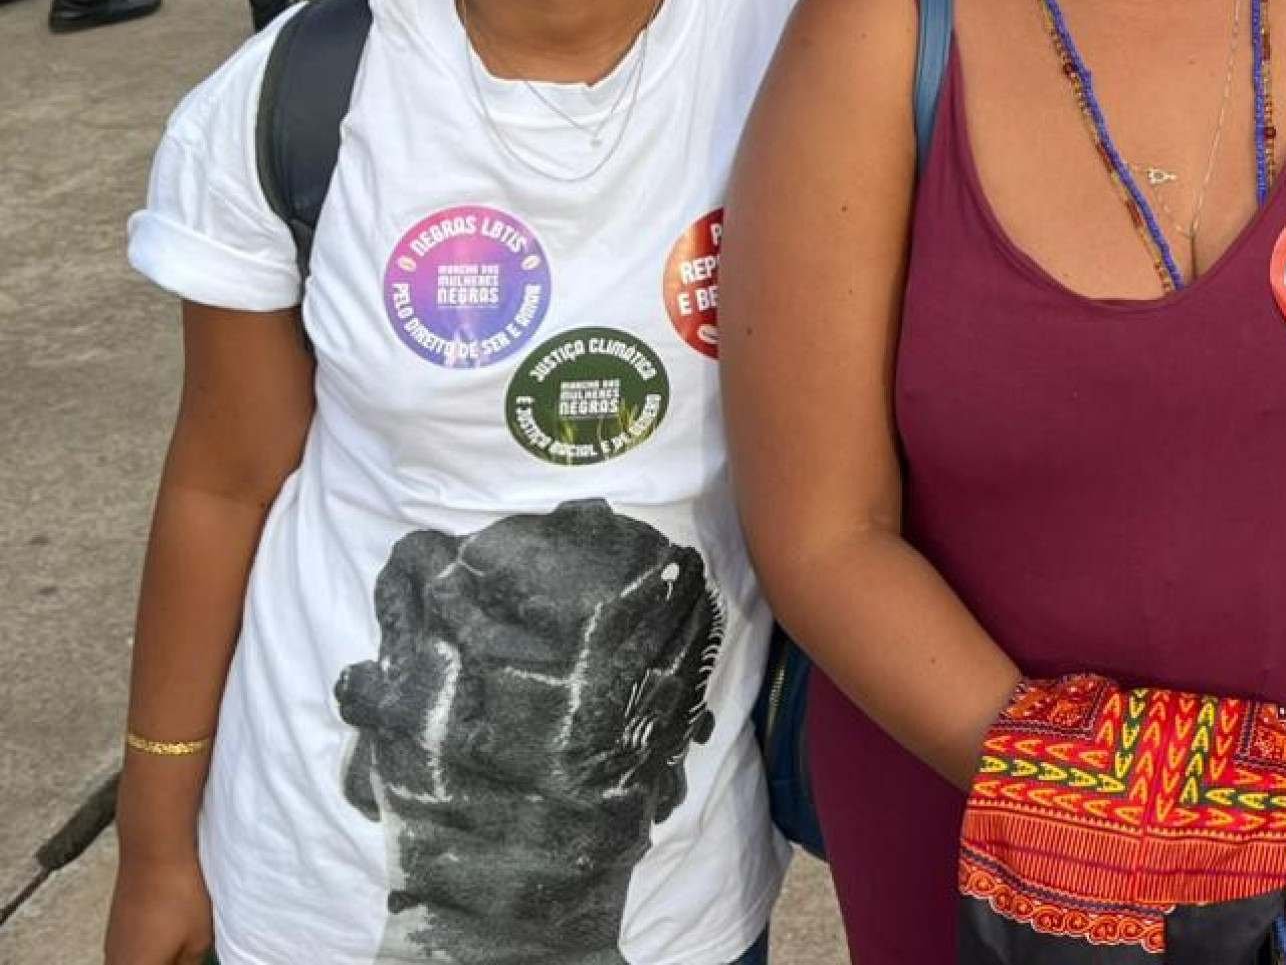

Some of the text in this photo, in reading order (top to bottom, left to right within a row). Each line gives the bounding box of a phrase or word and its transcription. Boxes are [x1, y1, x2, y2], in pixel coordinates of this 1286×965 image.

[409, 215, 529, 257] NEGRAS LBTIS
[437, 287, 500, 305] NEGRAS
[529, 337, 658, 383] JUSTIÇA CLIMÁTICA
[559, 398, 619, 416] NEGRAS
